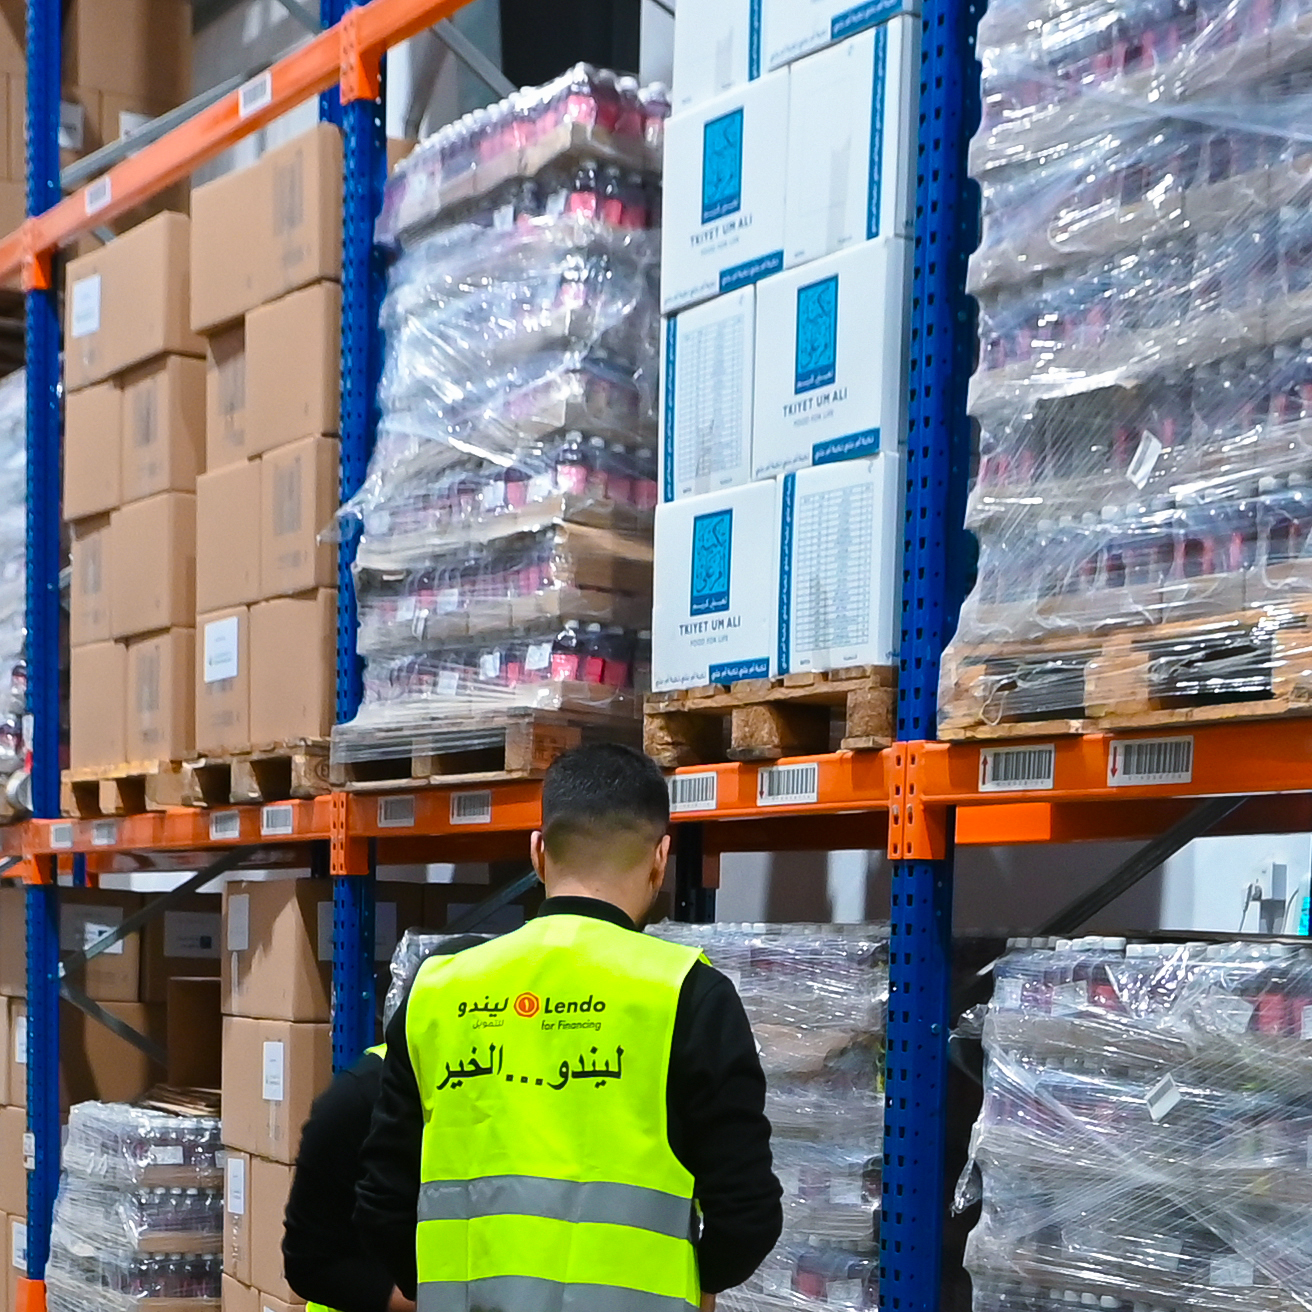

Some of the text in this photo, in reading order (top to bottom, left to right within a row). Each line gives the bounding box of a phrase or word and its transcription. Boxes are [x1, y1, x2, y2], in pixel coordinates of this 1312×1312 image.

[783, 387, 848, 417] TKIYET UM ALI
[679, 615, 741, 636] TKIYET UM ALI
[457, 995, 510, 1018] ليندو
[544, 994, 606, 1014] Lendo
[541, 1019, 602, 1032] for Financing
